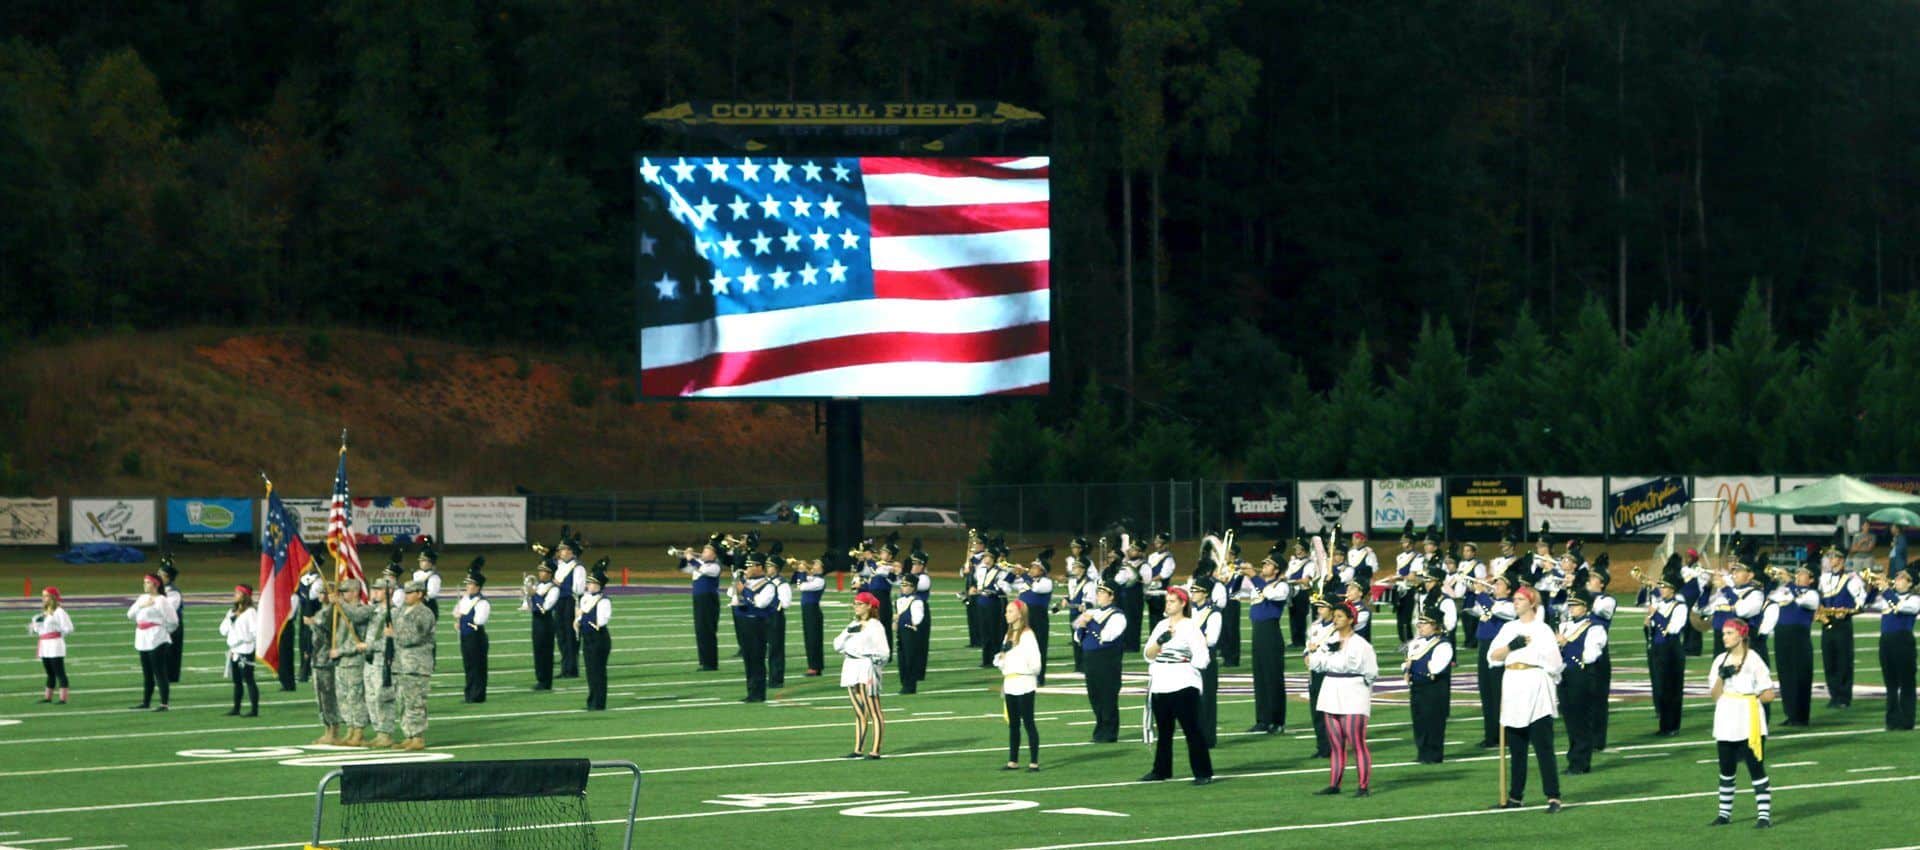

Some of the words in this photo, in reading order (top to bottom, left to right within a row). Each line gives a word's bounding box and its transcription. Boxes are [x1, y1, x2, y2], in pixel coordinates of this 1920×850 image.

[711, 103, 875, 118] COTTRELL
[884, 103, 977, 118] FIELD
[1379, 480, 1394, 489] GO
[1231, 495, 1288, 513] Tanner
[356, 510, 373, 518] The
[1376, 507, 1405, 522] NGN
[1635, 503, 1681, 525] Honda
[369, 525, 417, 534] FLORIST
